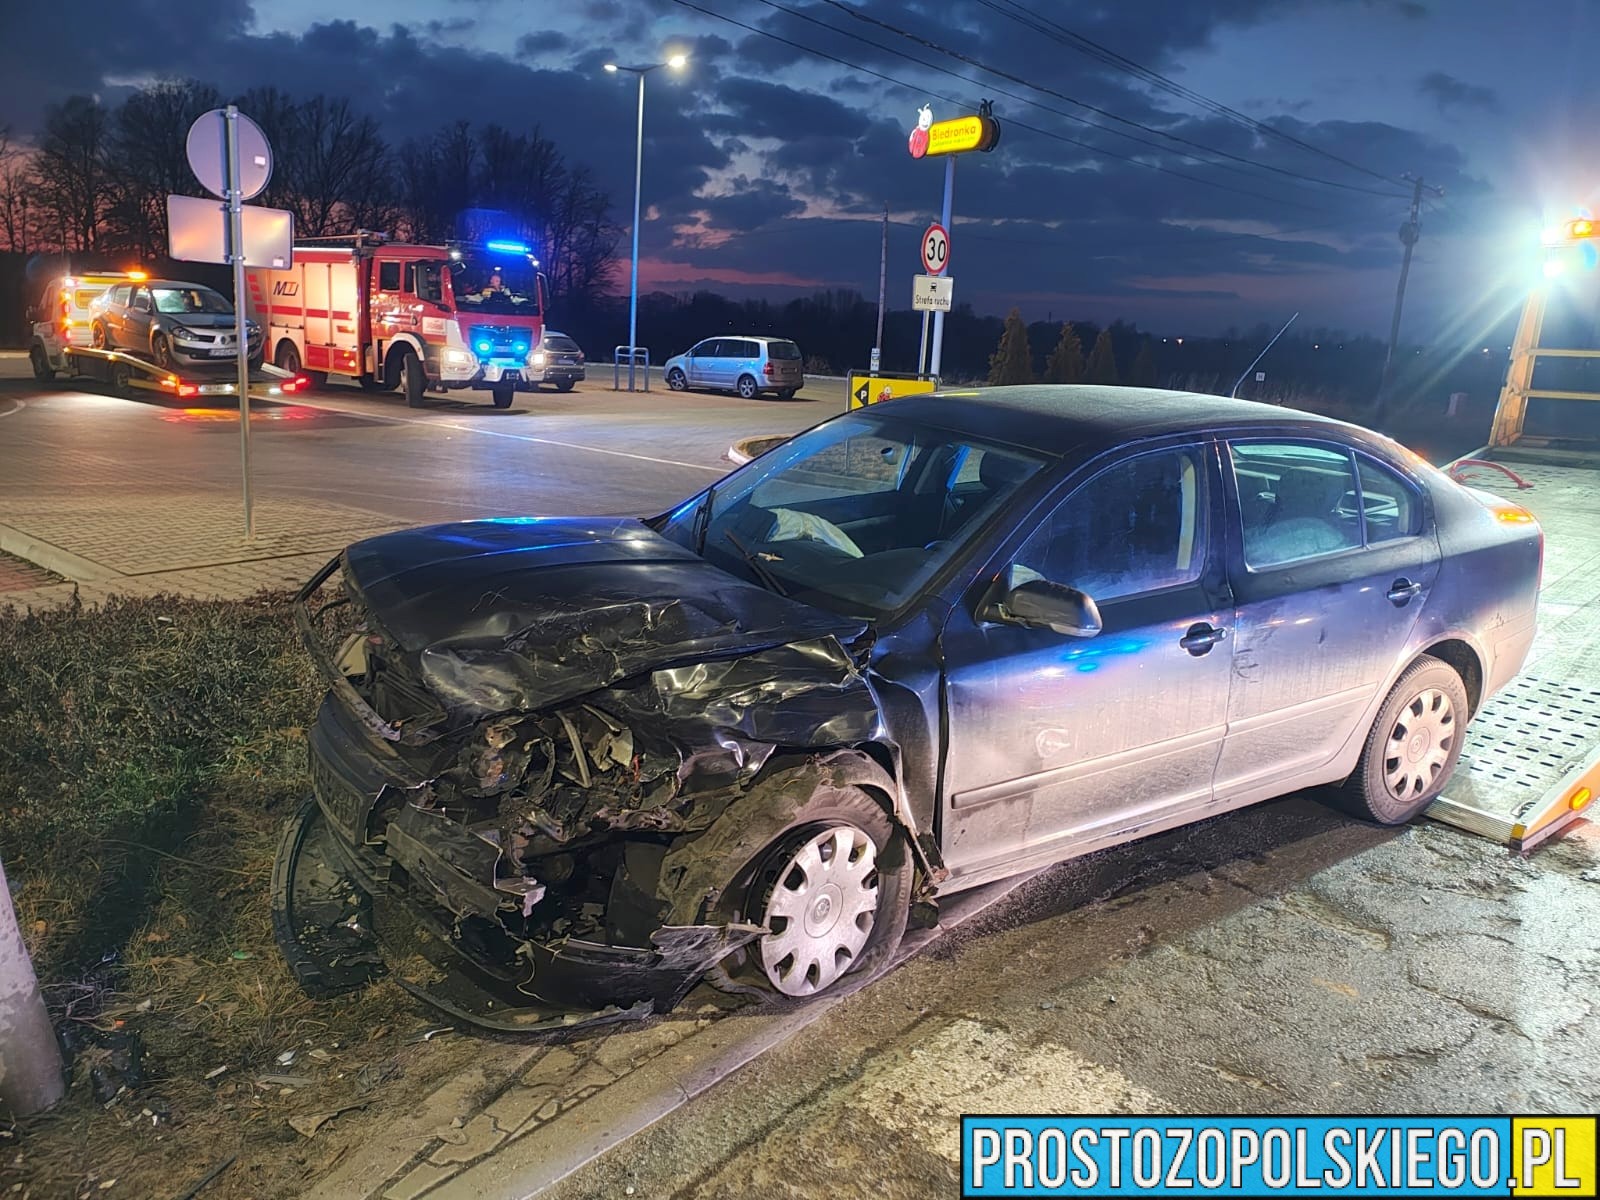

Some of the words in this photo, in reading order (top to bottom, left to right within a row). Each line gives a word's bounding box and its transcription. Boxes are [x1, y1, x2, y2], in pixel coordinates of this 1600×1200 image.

[932, 125, 976, 141] Biedronka
[927, 237, 946, 262] 30
[860, 390, 867, 400] P
